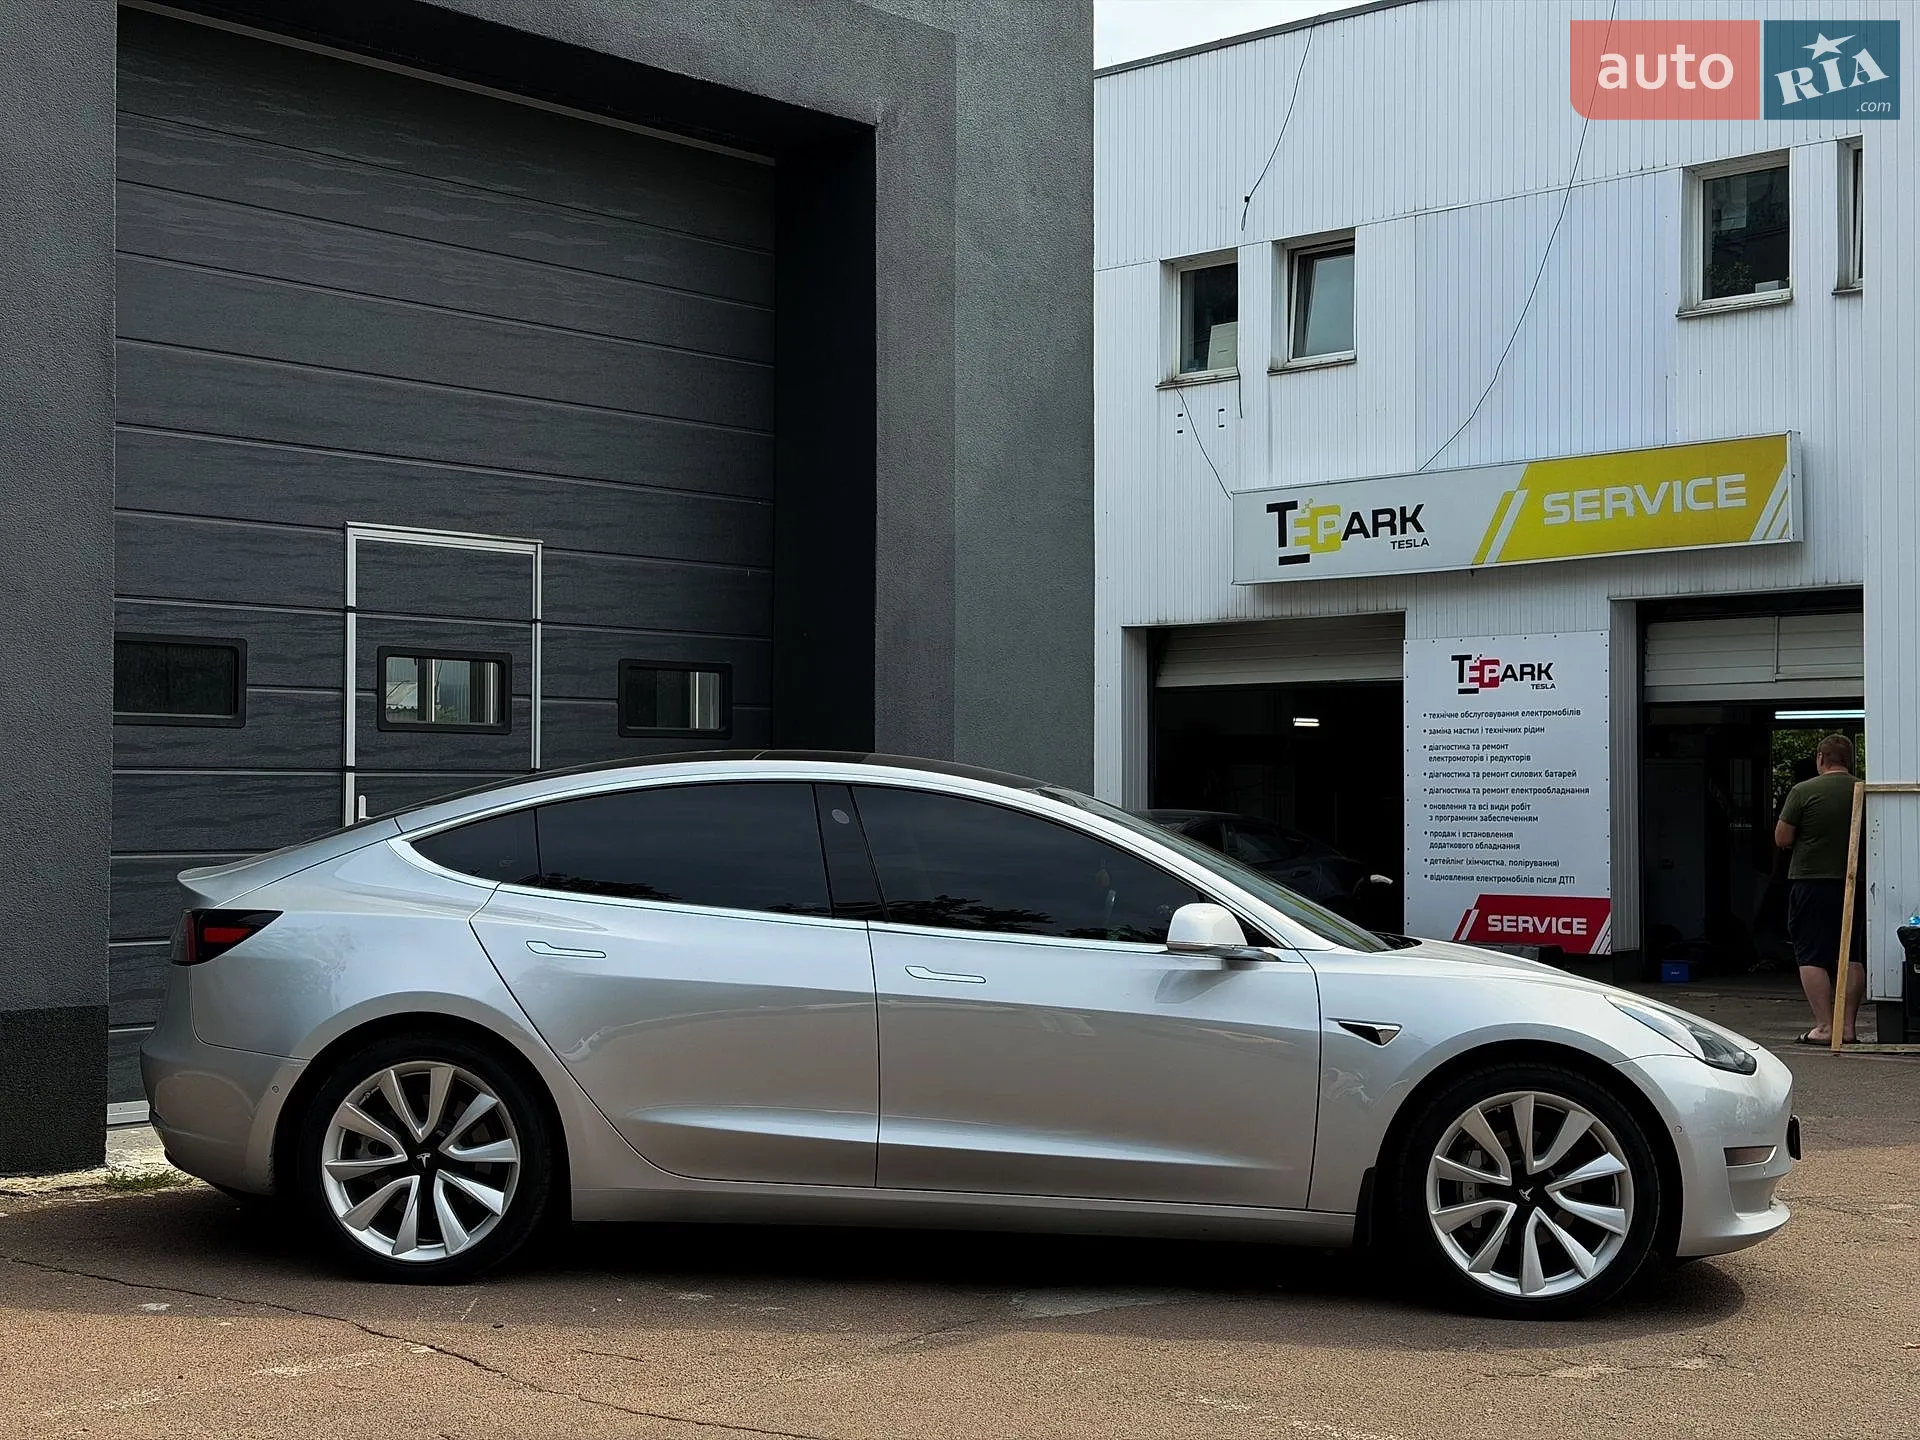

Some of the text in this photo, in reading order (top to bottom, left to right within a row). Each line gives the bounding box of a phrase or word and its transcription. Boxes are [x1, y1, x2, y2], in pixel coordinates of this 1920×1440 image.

[1543, 473, 1747, 525] SERVICE
[1390, 537, 1430, 550] TESLA
[1428, 708, 1581, 719] технічне обслуговування електромобілів
[1428, 727, 1452, 735] заміна
[1453, 727, 1479, 735] мастил
[1485, 726, 1522, 734] технічних
[1523, 726, 1545, 735] рідин
[1428, 743, 1509, 752] діагностика та ремонт
[1428, 754, 1484, 763] електромоторів
[1490, 754, 1531, 763] редукторів
[1428, 770, 1471, 779] діагностика
[1481, 770, 1509, 779] ремонт
[1510, 770, 1542, 778] силових
[1544, 769, 1577, 779] батарей
[1428, 786, 1471, 795] діагностика
[1482, 786, 1509, 795] ремонт
[1511, 786, 1590, 795] електрообладнання
[1478, 802, 1489, 811] всі
[1490, 803, 1509, 812] види
[1511, 802, 1531, 812] робіт
[1434, 814, 1478, 823] програмним
[1429, 831, 1457, 839] продаж
[1462, 831, 1514, 839] встановлення
[1429, 842, 1520, 851] додаткового обладнання
[1429, 857, 1464, 866] детейлінг
[1508, 859, 1560, 868] полірування)
[1429, 874, 1576, 885] відновлення електромобілів після ДТП
[1487, 914, 1587, 935] SERVICE
